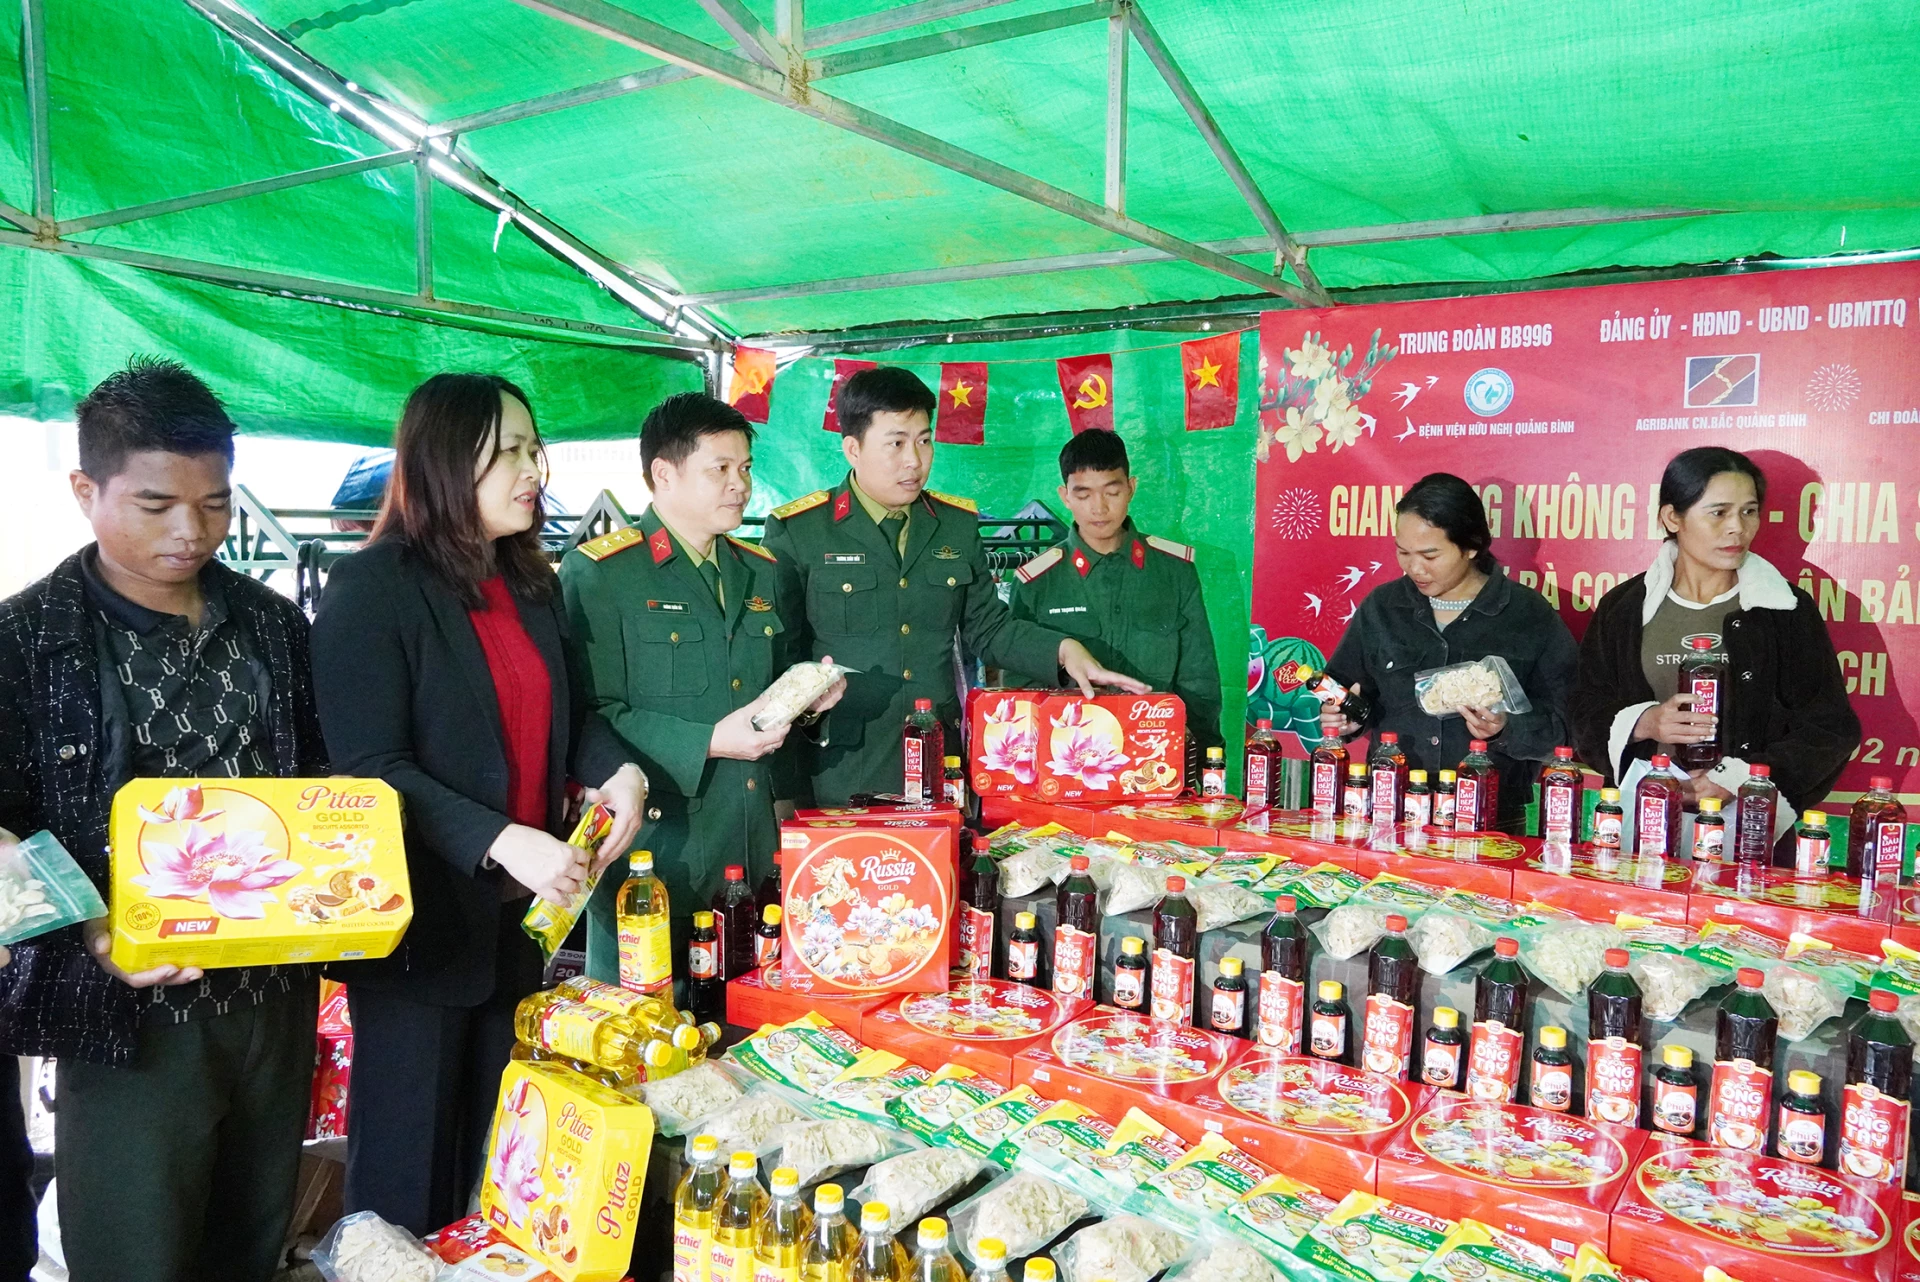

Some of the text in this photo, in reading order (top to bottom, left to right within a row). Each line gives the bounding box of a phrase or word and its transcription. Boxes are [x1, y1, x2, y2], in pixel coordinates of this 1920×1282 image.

[1600, 310, 1644, 343] ĐẢNG
[1650, 308, 1672, 339] ỦY
[1692, 311, 1740, 337] HĐND
[1758, 305, 1809, 333] UBND
[1828, 299, 1906, 328] UBMTTQ
[1399, 324, 1552, 355] TRUNG ĐOÀN BB996
[1419, 418, 1575, 440] BỆNH VIỆN HỮU NGHỊ QUẢNG BÌNH
[1635, 413, 1807, 431] AGRIBANK CN.BẮC QUẢNG BÌNH
[1869, 412, 1890, 425] CHI
[1513, 472, 1635, 540] KHÔNG
[1799, 482, 1899, 544] CHIA
[1860, 564, 1920, 624] BẢ
[1129, 699, 1175, 721] Pitaz
[1138, 720, 1166, 728] GOLD
[297, 785, 378, 811] Pitaz
[996, 784, 1015, 792] NEW
[1065, 790, 1083, 798] NEW
[315, 812, 365, 823] GOLD
[860, 855, 917, 885] Russia
[134, 911, 153, 922] 100%
[175, 920, 212, 933] NEW
[618, 933, 641, 945] rchid
[555, 967, 577, 978] 20
[820, 1026, 862, 1055] MEIZAN
[1151, 1028, 1210, 1048] Russia
[1327, 1073, 1388, 1096] Russia
[556, 1101, 595, 1142] Pitaz
[1078, 1115, 1114, 1138] MEIZ
[1521, 1116, 1596, 1141] Russia
[560, 1133, 583, 1155] GOLD
[1144, 1136, 1181, 1158] MEIZ
[1219, 1152, 1265, 1181] MEIZA
[1756, 1166, 1844, 1198] Russia
[596, 1161, 631, 1240] Pitaz
[625, 1174, 643, 1222] GOLD
[493, 1210, 507, 1226] NEW
[1379, 1206, 1448, 1233] MEIZAN
[674, 1234, 701, 1250] rchid
[711, 1252, 734, 1268] rchid
[753, 1264, 786, 1282] rchid
